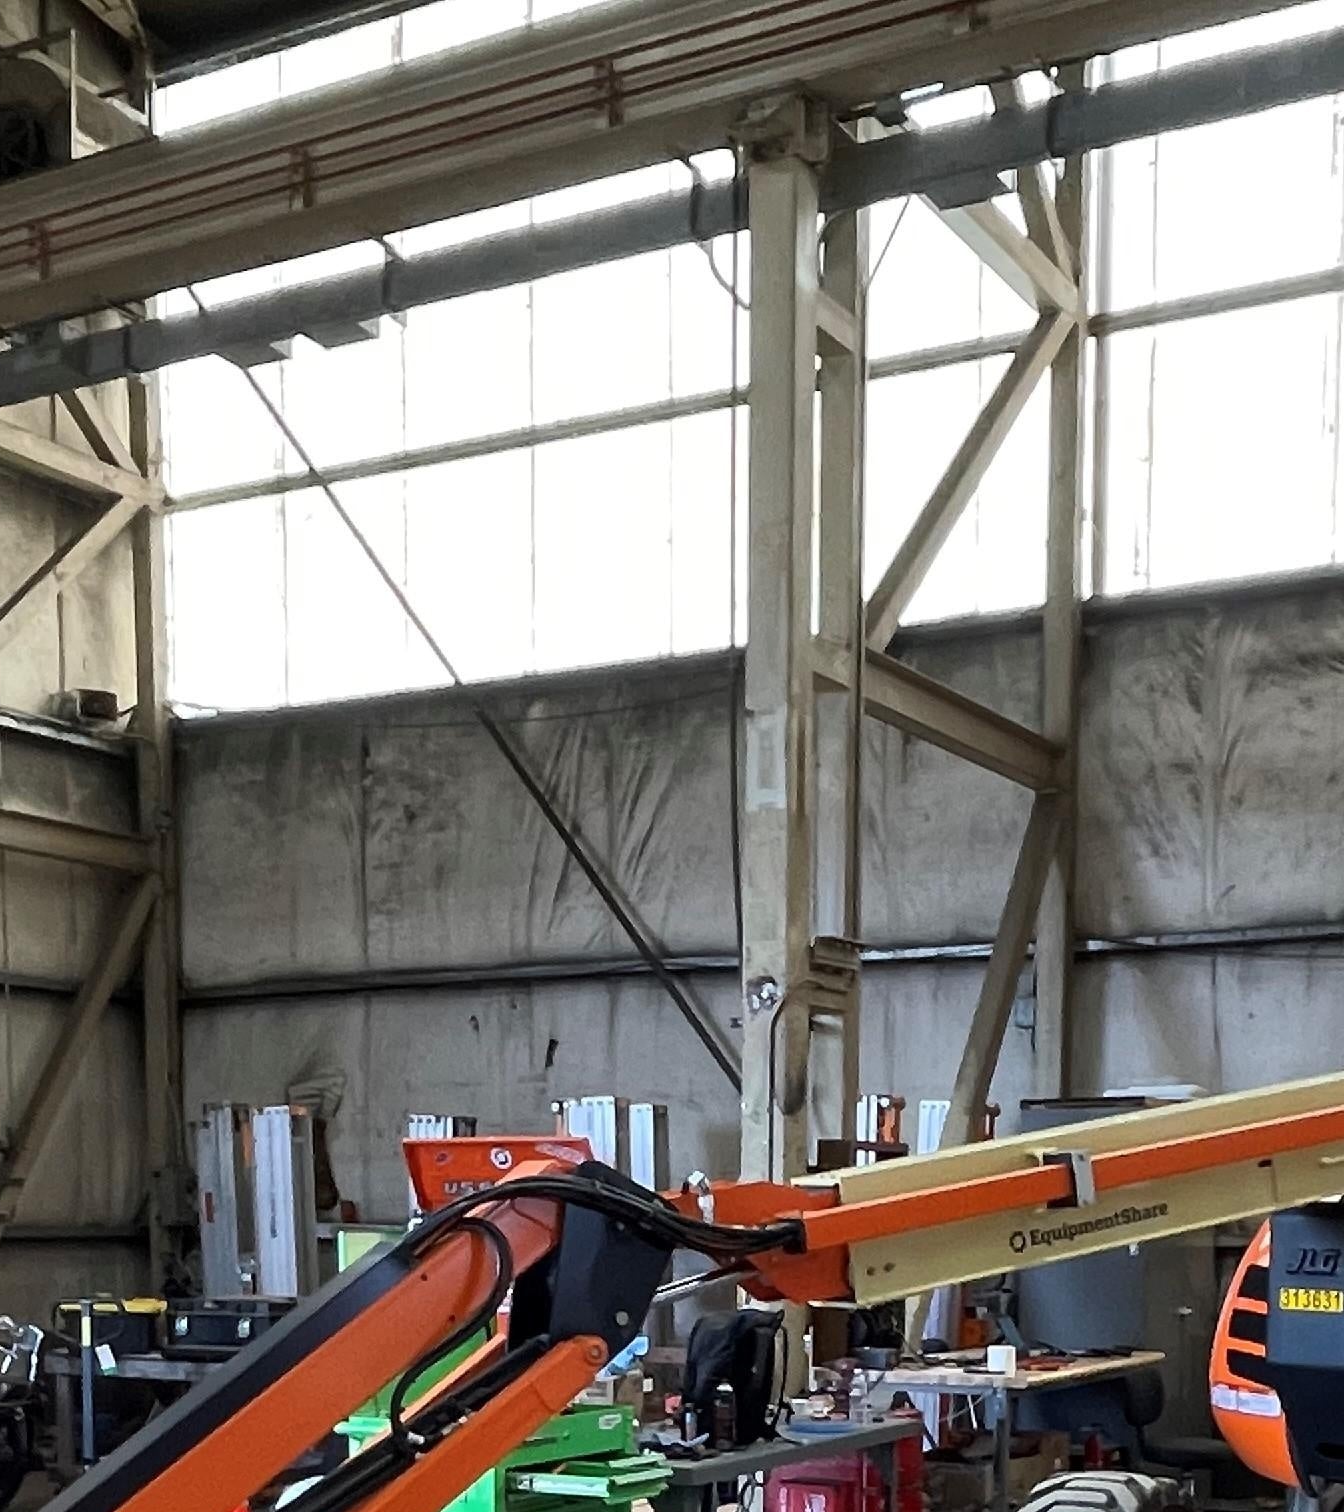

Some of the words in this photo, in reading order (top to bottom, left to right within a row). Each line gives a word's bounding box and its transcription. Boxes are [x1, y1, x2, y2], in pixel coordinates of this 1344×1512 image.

[1029, 1202, 1169, 1246] EquipmentShare
[1285, 1247, 1342, 1276] JLG
[1280, 1288, 1341, 1310] 313631
